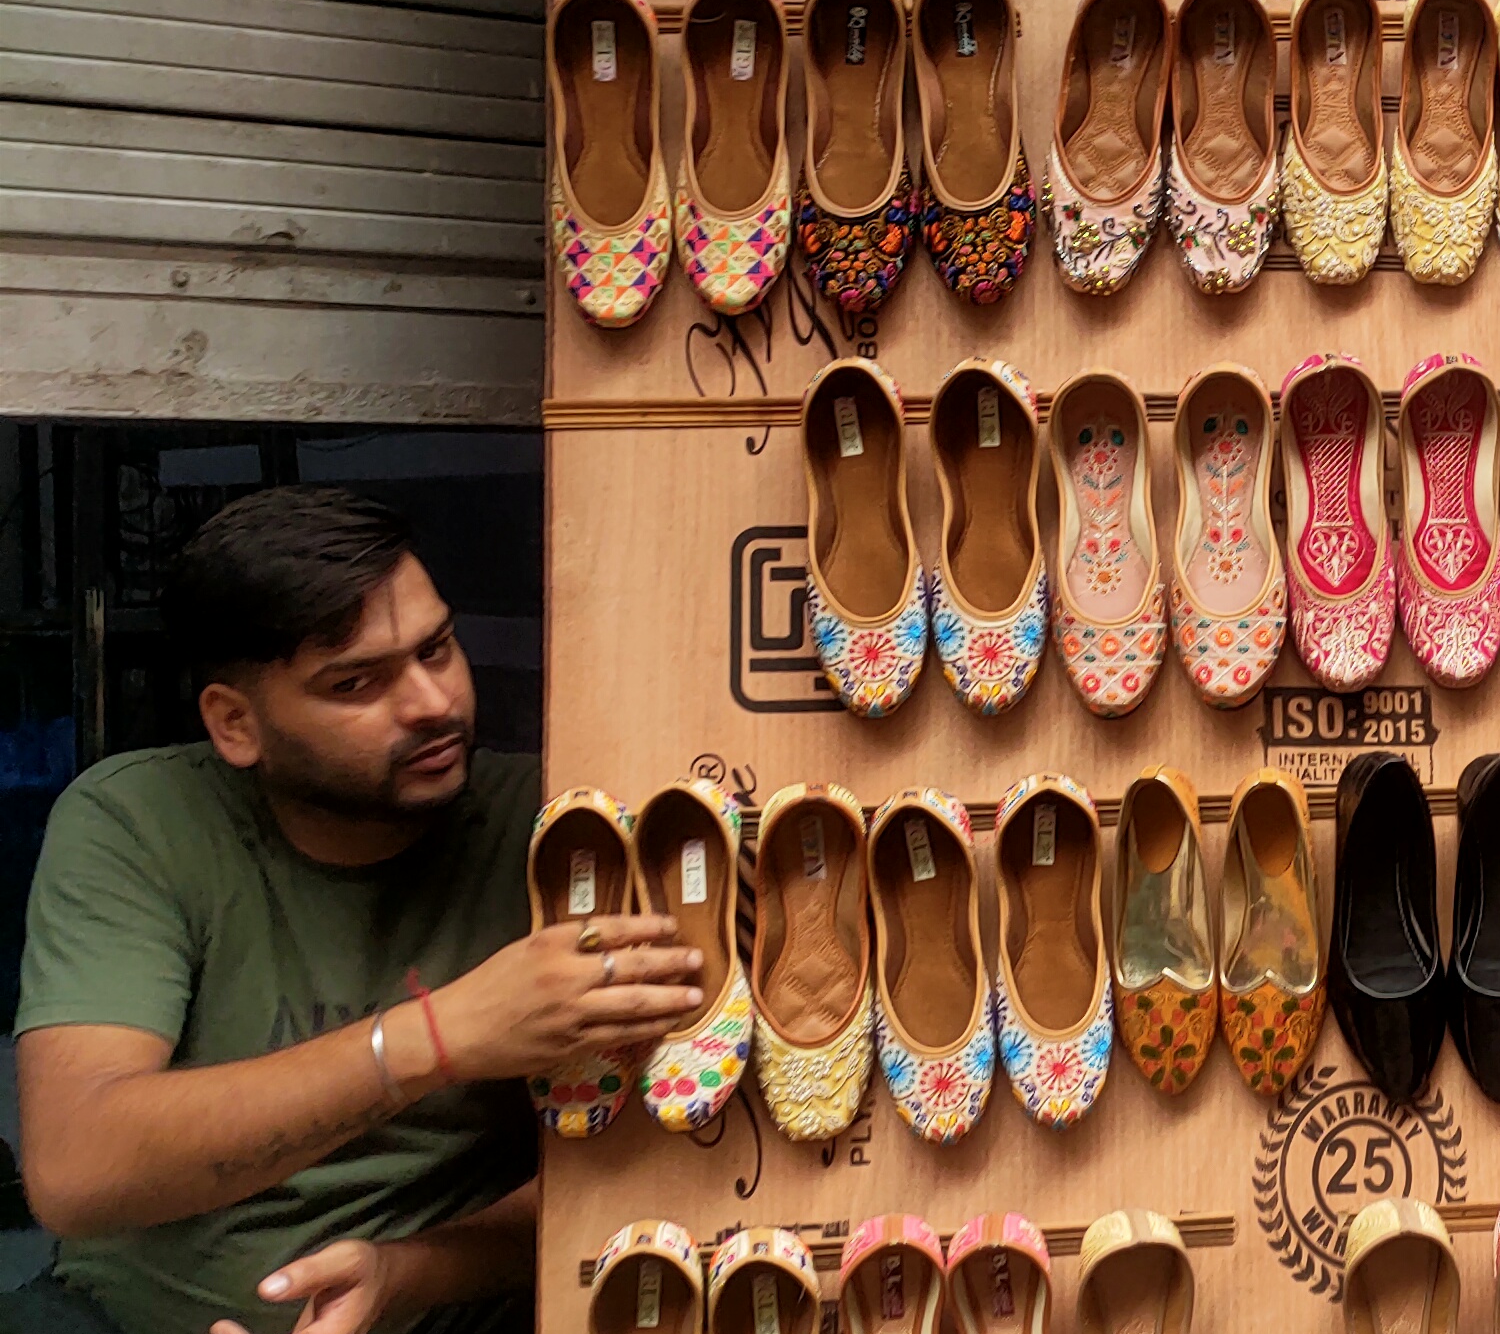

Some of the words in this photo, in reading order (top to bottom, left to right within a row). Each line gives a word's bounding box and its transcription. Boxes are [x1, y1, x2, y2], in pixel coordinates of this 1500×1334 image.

[1272, 695, 1358, 740] ISO:
[1363, 690, 1423, 715] 9001
[1363, 718, 1426, 744] 2015
[1301, 1091, 1423, 1143] WARRANTY
[1326, 1138, 1394, 1195] 25
